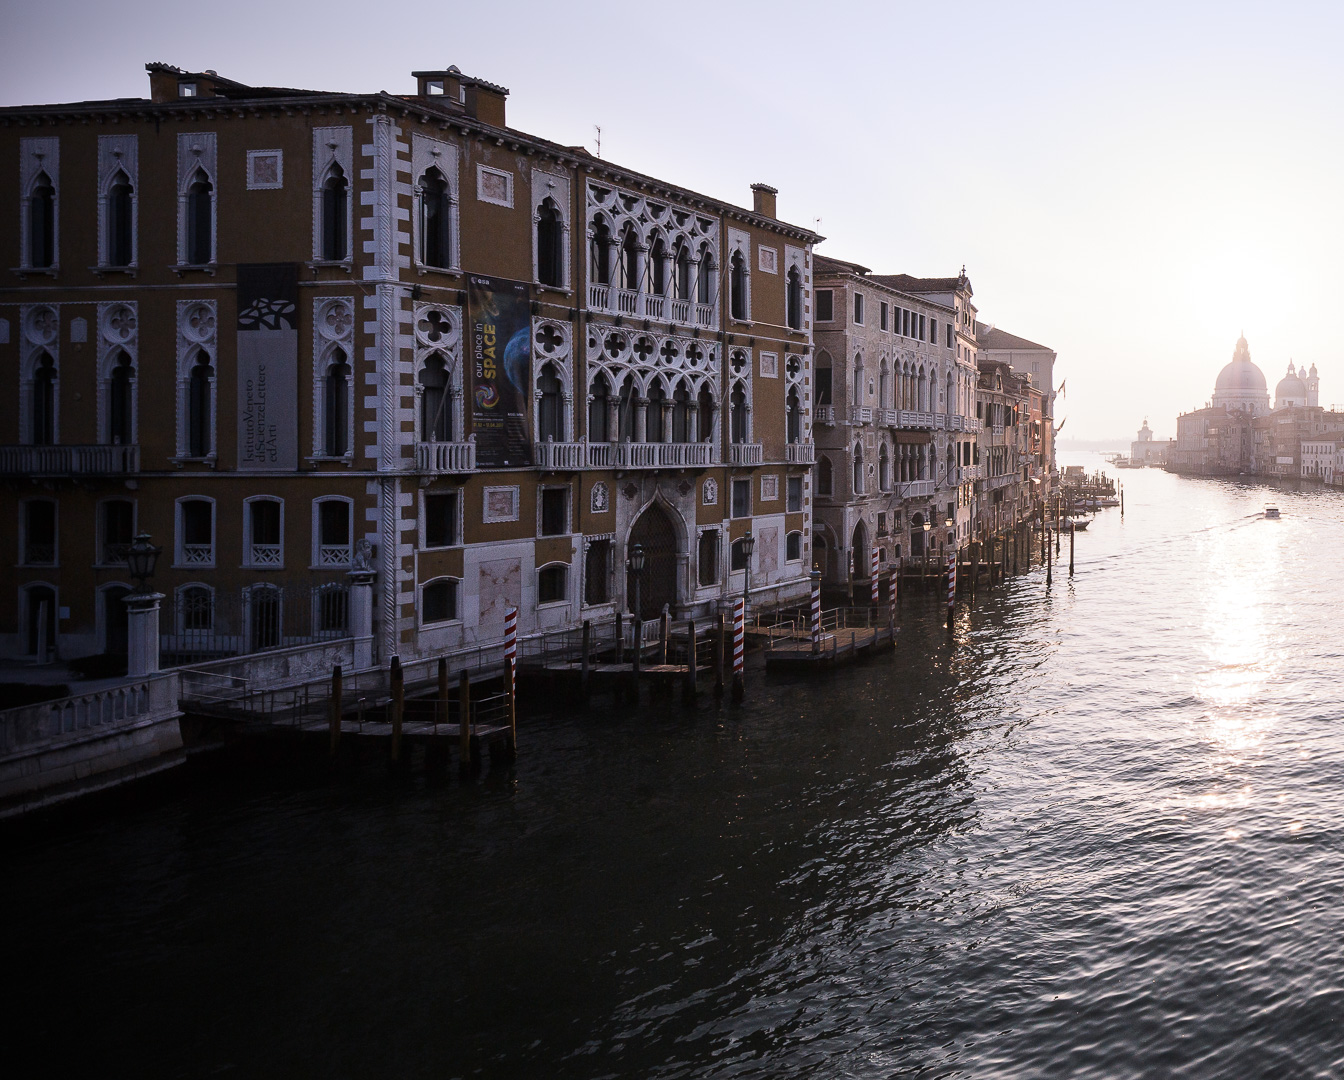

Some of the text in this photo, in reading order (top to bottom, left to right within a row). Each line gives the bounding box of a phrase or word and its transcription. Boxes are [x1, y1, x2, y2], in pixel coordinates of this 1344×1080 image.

[473, 323, 483, 332] in
[474, 334, 484, 359] place
[483, 323, 497, 379] SPACE
